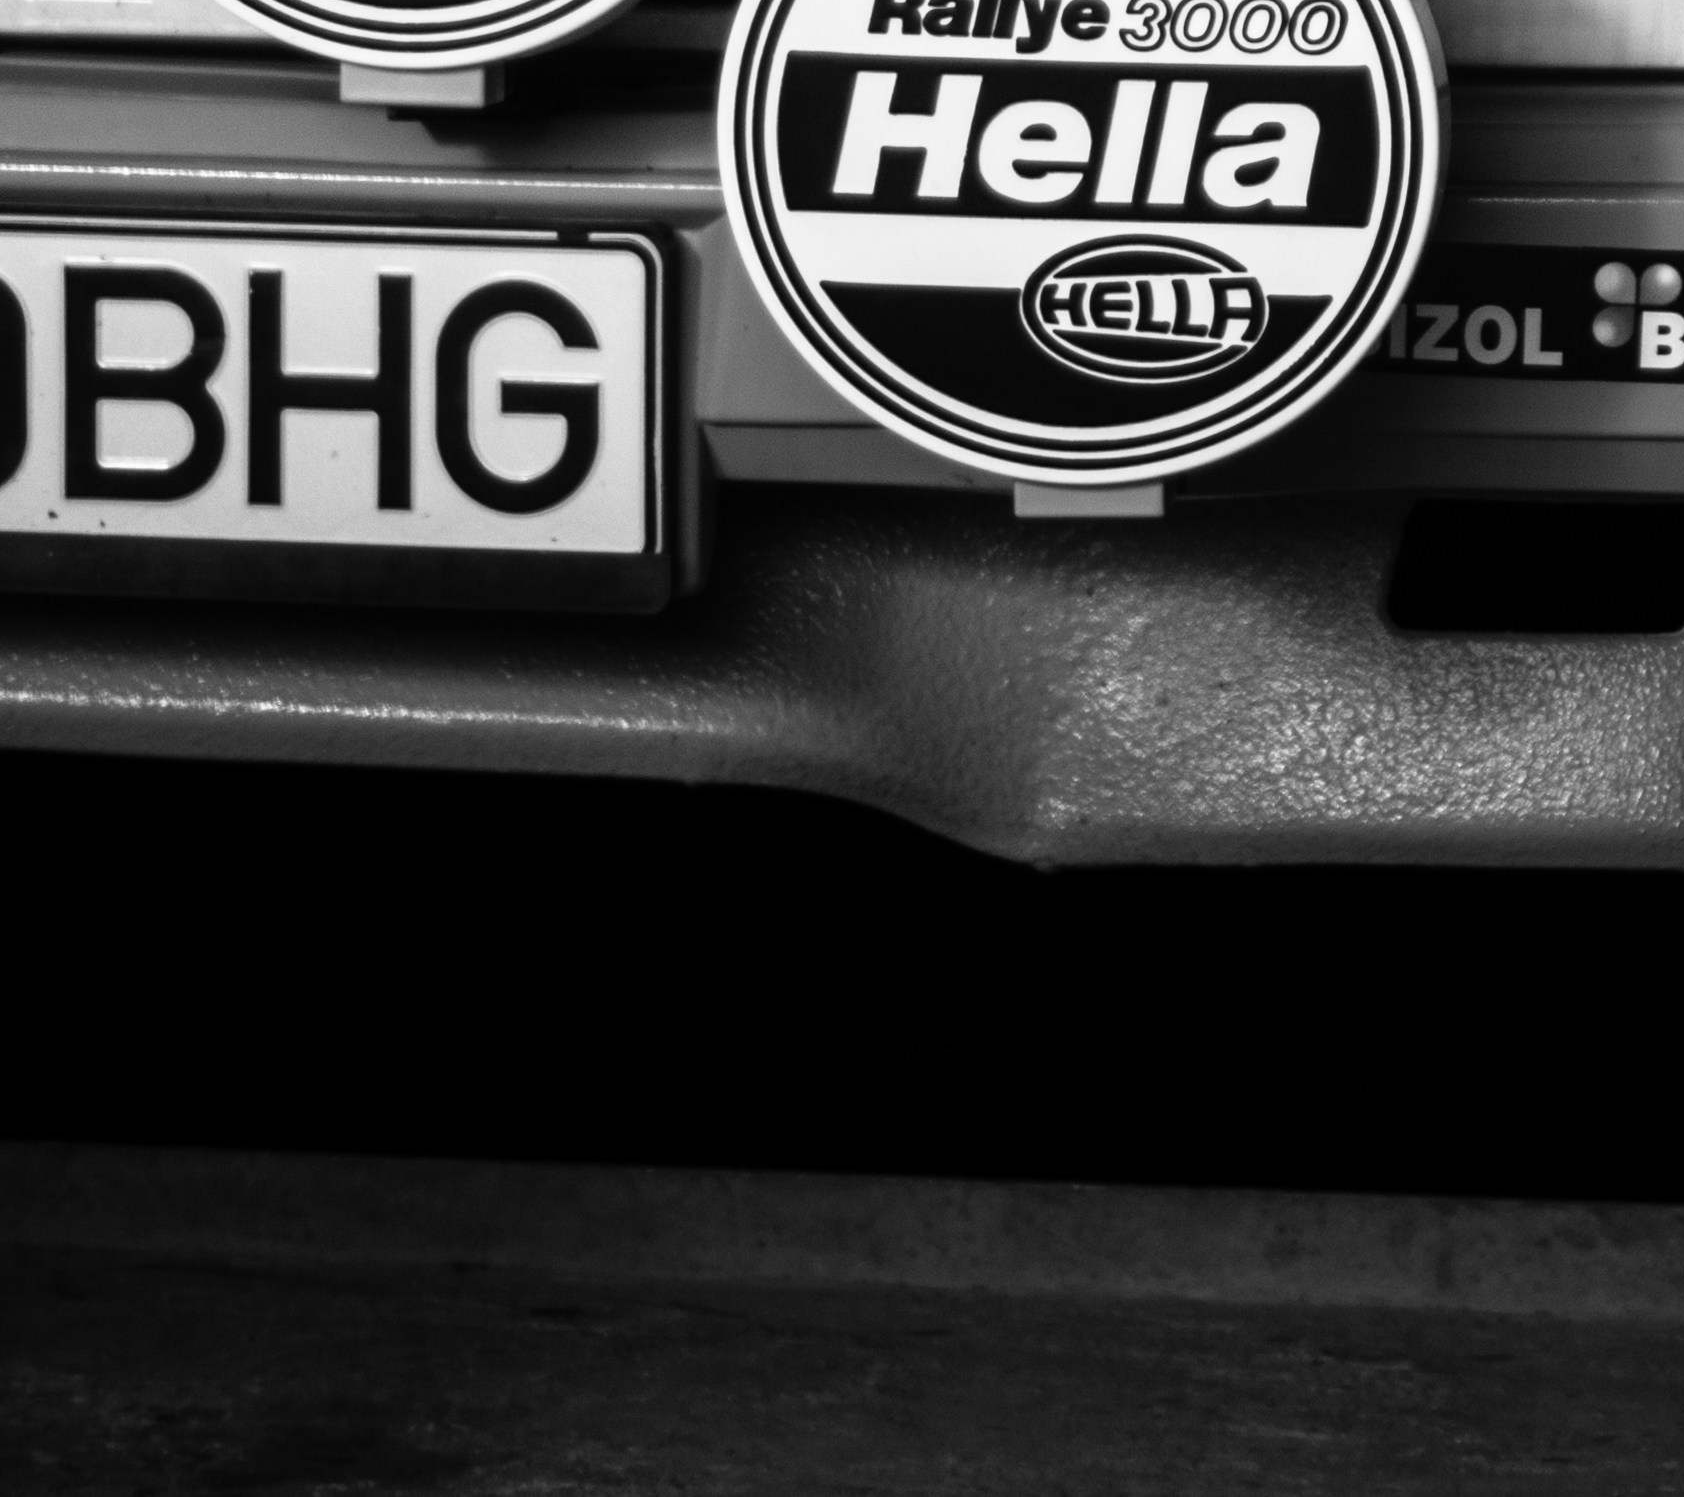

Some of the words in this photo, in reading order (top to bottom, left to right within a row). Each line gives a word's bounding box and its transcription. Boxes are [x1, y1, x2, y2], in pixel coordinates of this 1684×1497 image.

[832, 71, 1321, 208] Hella
[1040, 276, 1263, 344] HELLA
[1367, 304, 1563, 366] IZOL
[0, 260, 601, 515] BHG
